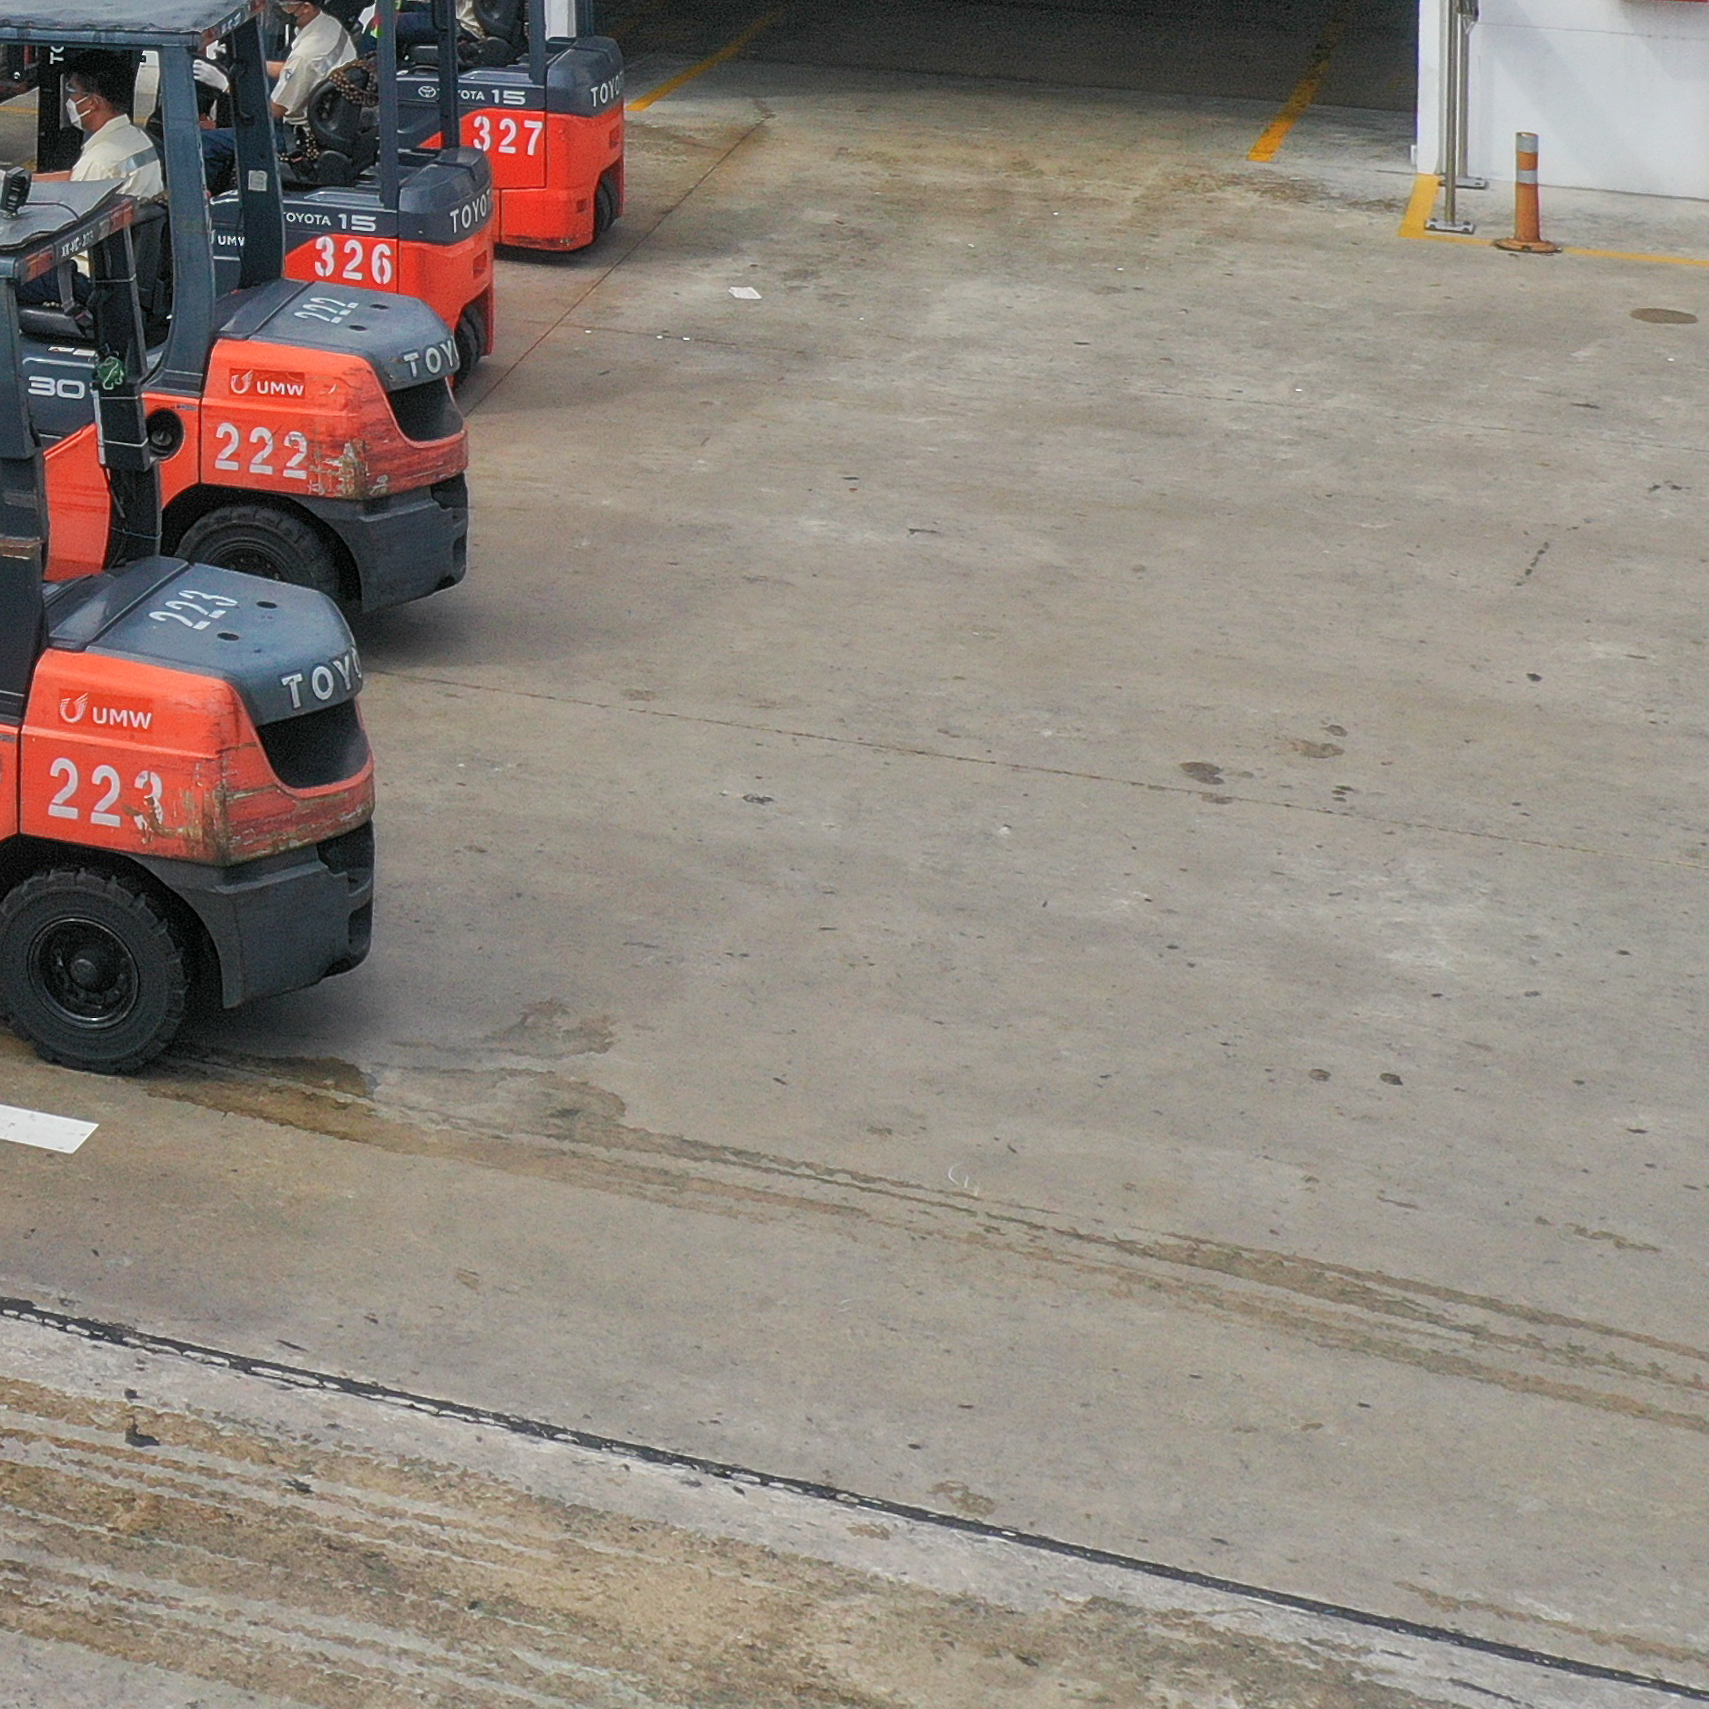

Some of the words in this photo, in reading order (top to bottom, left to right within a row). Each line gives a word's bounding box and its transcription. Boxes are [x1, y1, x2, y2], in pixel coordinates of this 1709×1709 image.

[491, 89, 526, 105] 15
[473, 115, 543, 156] 327
[283, 211, 332, 227] OYOTA
[338, 213, 376, 232] 15
[314, 236, 392, 285] 326
[28, 376, 85, 400] 30
[256, 379, 304, 396] UMW
[214, 422, 308, 480] 222
[148, 589, 239, 631] 223
[91, 705, 153, 731] UMW
[47, 756, 163, 833] 223
